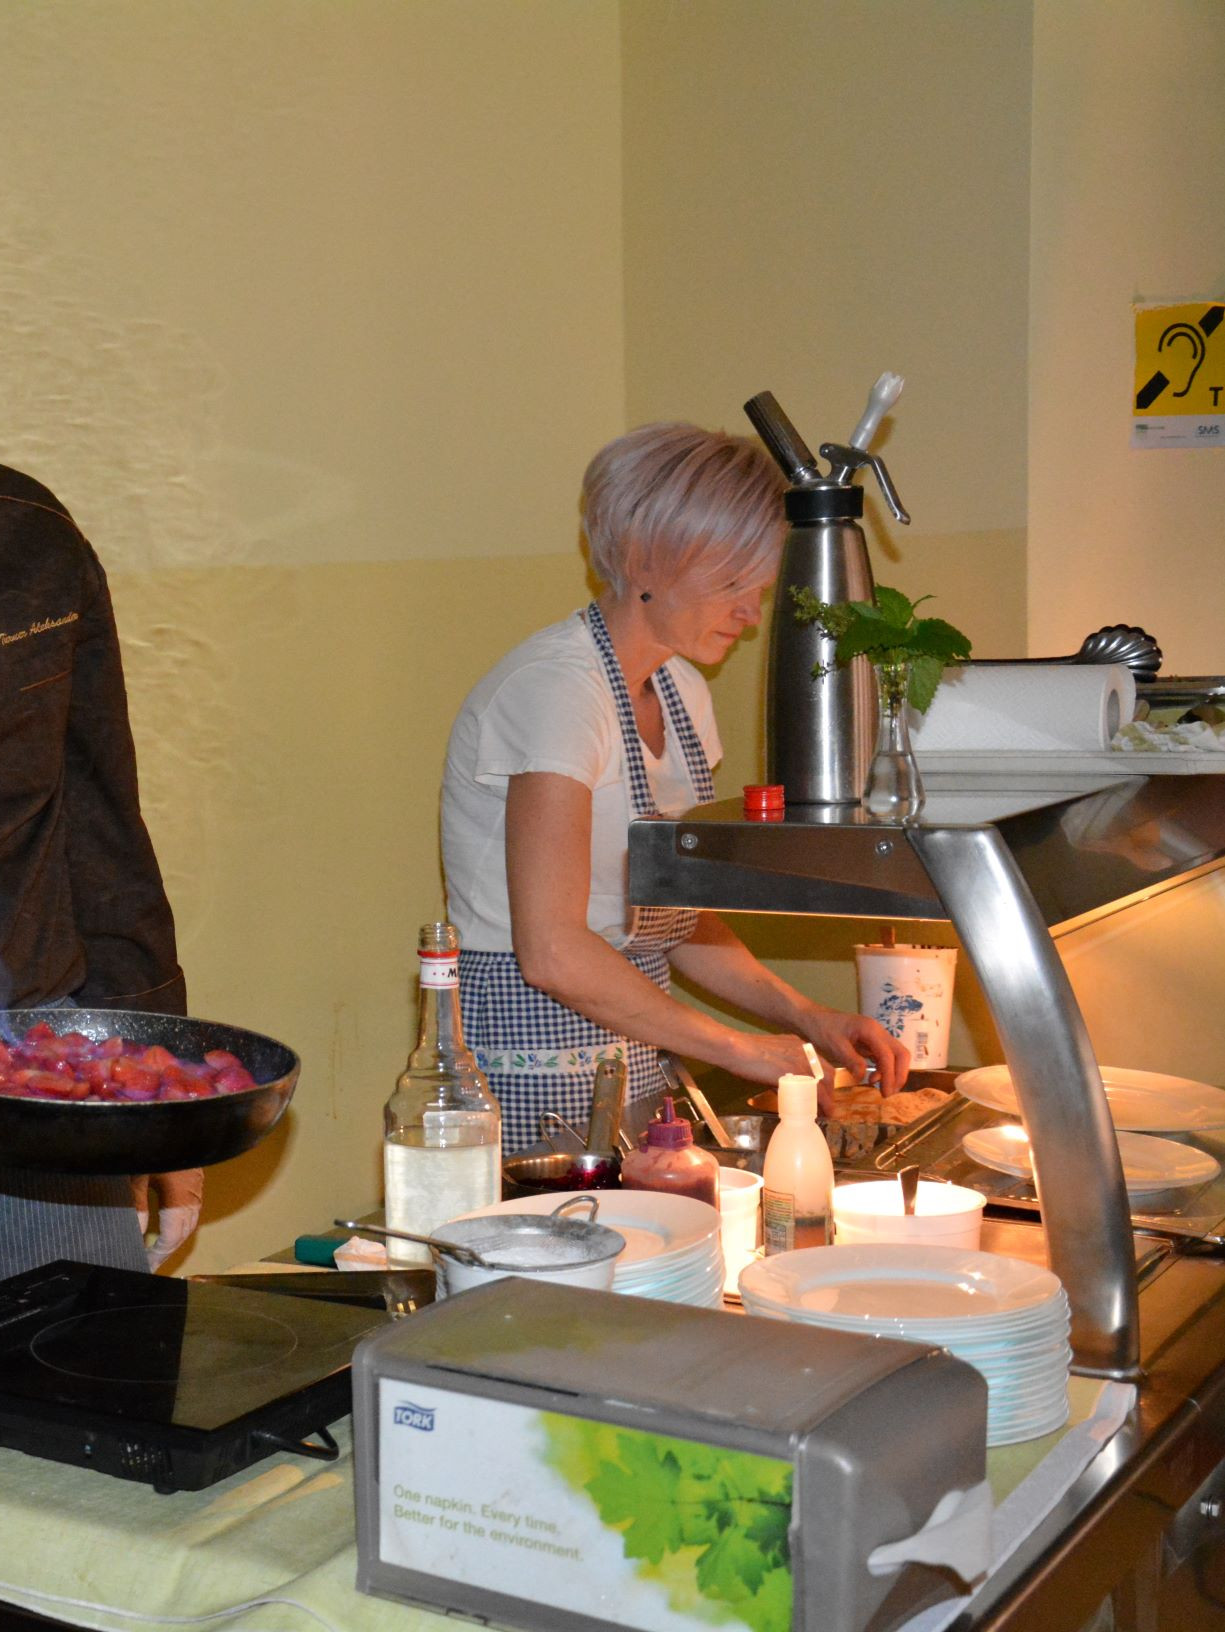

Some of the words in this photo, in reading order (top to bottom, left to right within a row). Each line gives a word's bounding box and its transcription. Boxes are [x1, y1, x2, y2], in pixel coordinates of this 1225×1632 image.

[1209, 387, 1223, 406] T
[394, 1408, 433, 1430] TORK
[393, 1484, 422, 1502] One
[425, 1492, 476, 1515] napkin.
[480, 1503, 521, 1528] Every
[524, 1513, 561, 1535] time.
[394, 1504, 435, 1525] Better
[439, 1514, 460, 1531] for
[463, 1520, 486, 1538] the
[490, 1528, 584, 1561] environment.
